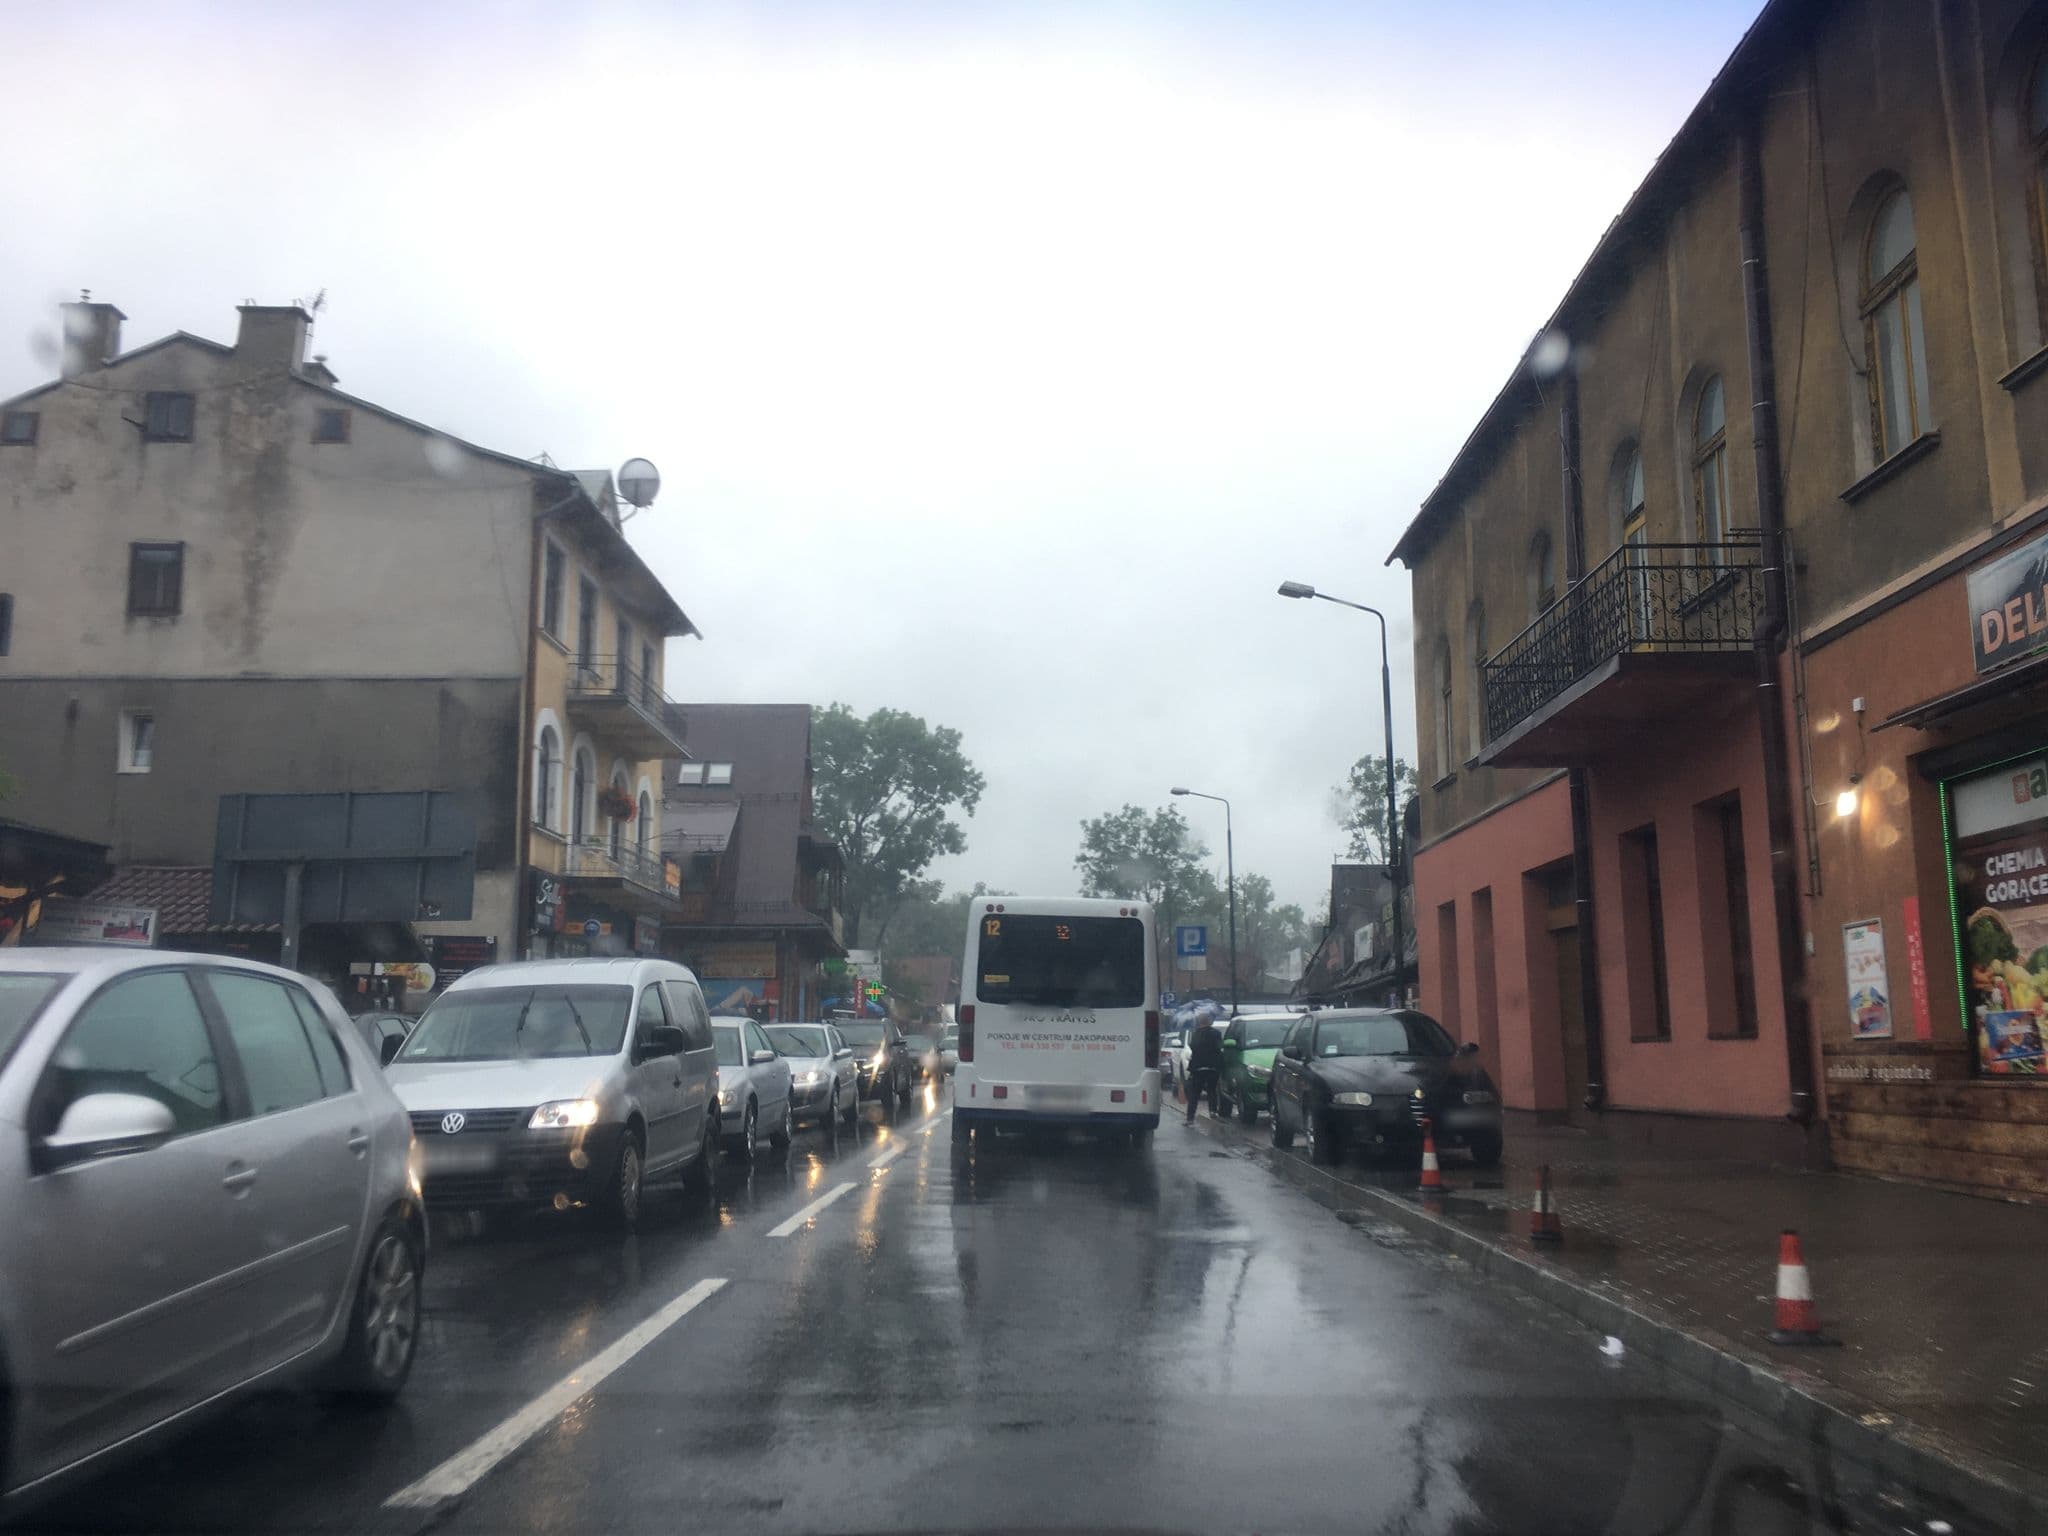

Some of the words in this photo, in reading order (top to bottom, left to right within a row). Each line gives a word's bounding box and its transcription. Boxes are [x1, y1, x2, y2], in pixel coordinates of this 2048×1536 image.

[1985, 847, 2047, 877] CHEMIA
[1985, 873, 2048, 903] GORĄCE
[985, 919, 1001, 936] 12
[1022, 1033, 1031, 1041] W
[1031, 1033, 1072, 1042] CENTRUM
[1073, 1034, 1131, 1043] ZAKOPANEGO
